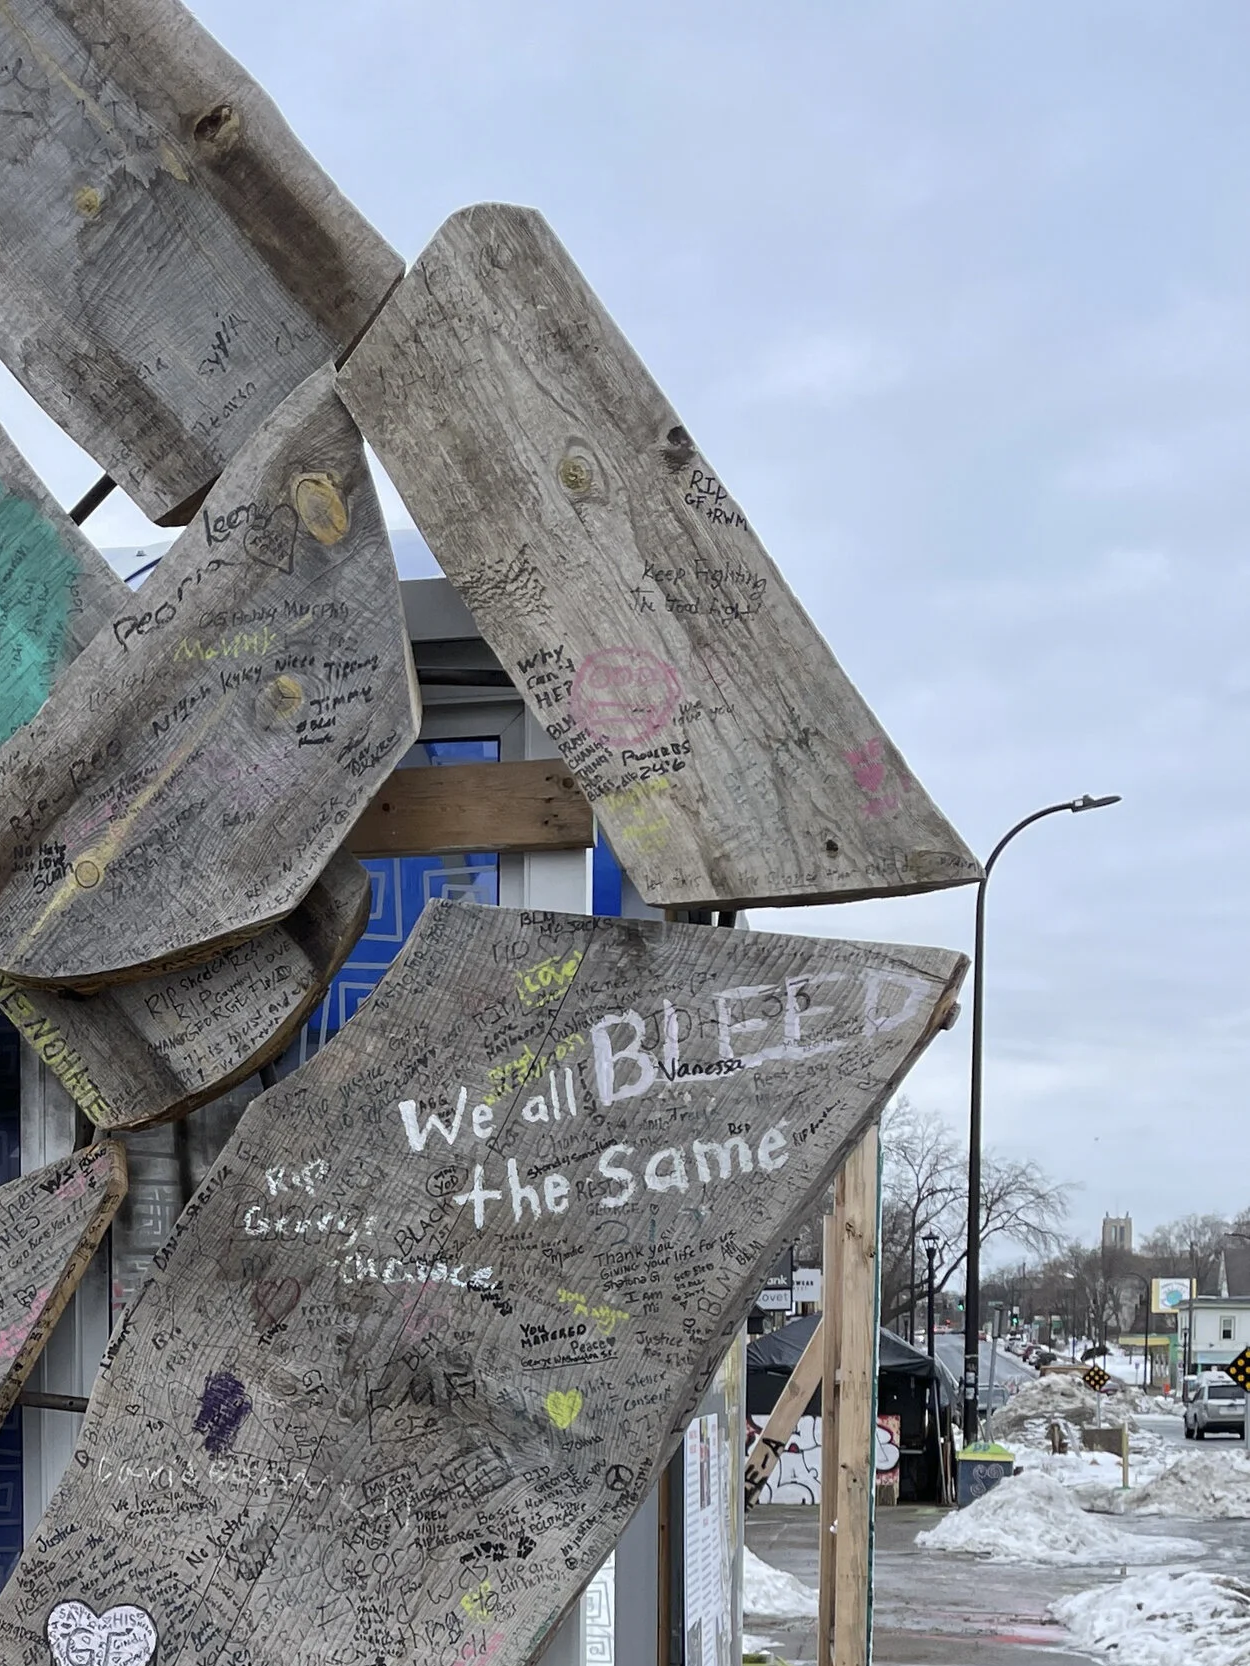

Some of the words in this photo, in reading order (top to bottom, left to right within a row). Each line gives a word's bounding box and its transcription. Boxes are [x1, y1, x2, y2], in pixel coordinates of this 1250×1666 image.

[545, 713, 577, 742] BLM
[398, 1086, 496, 1152] We
[521, 1066, 578, 1124] all
[588, 968, 934, 1107] BLEED
[657, 1057, 746, 1082] Vanessa
[453, 1157, 570, 1230] the
[393, 1198, 456, 1258] BLACK
[594, 1247, 644, 1268] Thank
[571, 1340, 607, 1353] Peace
